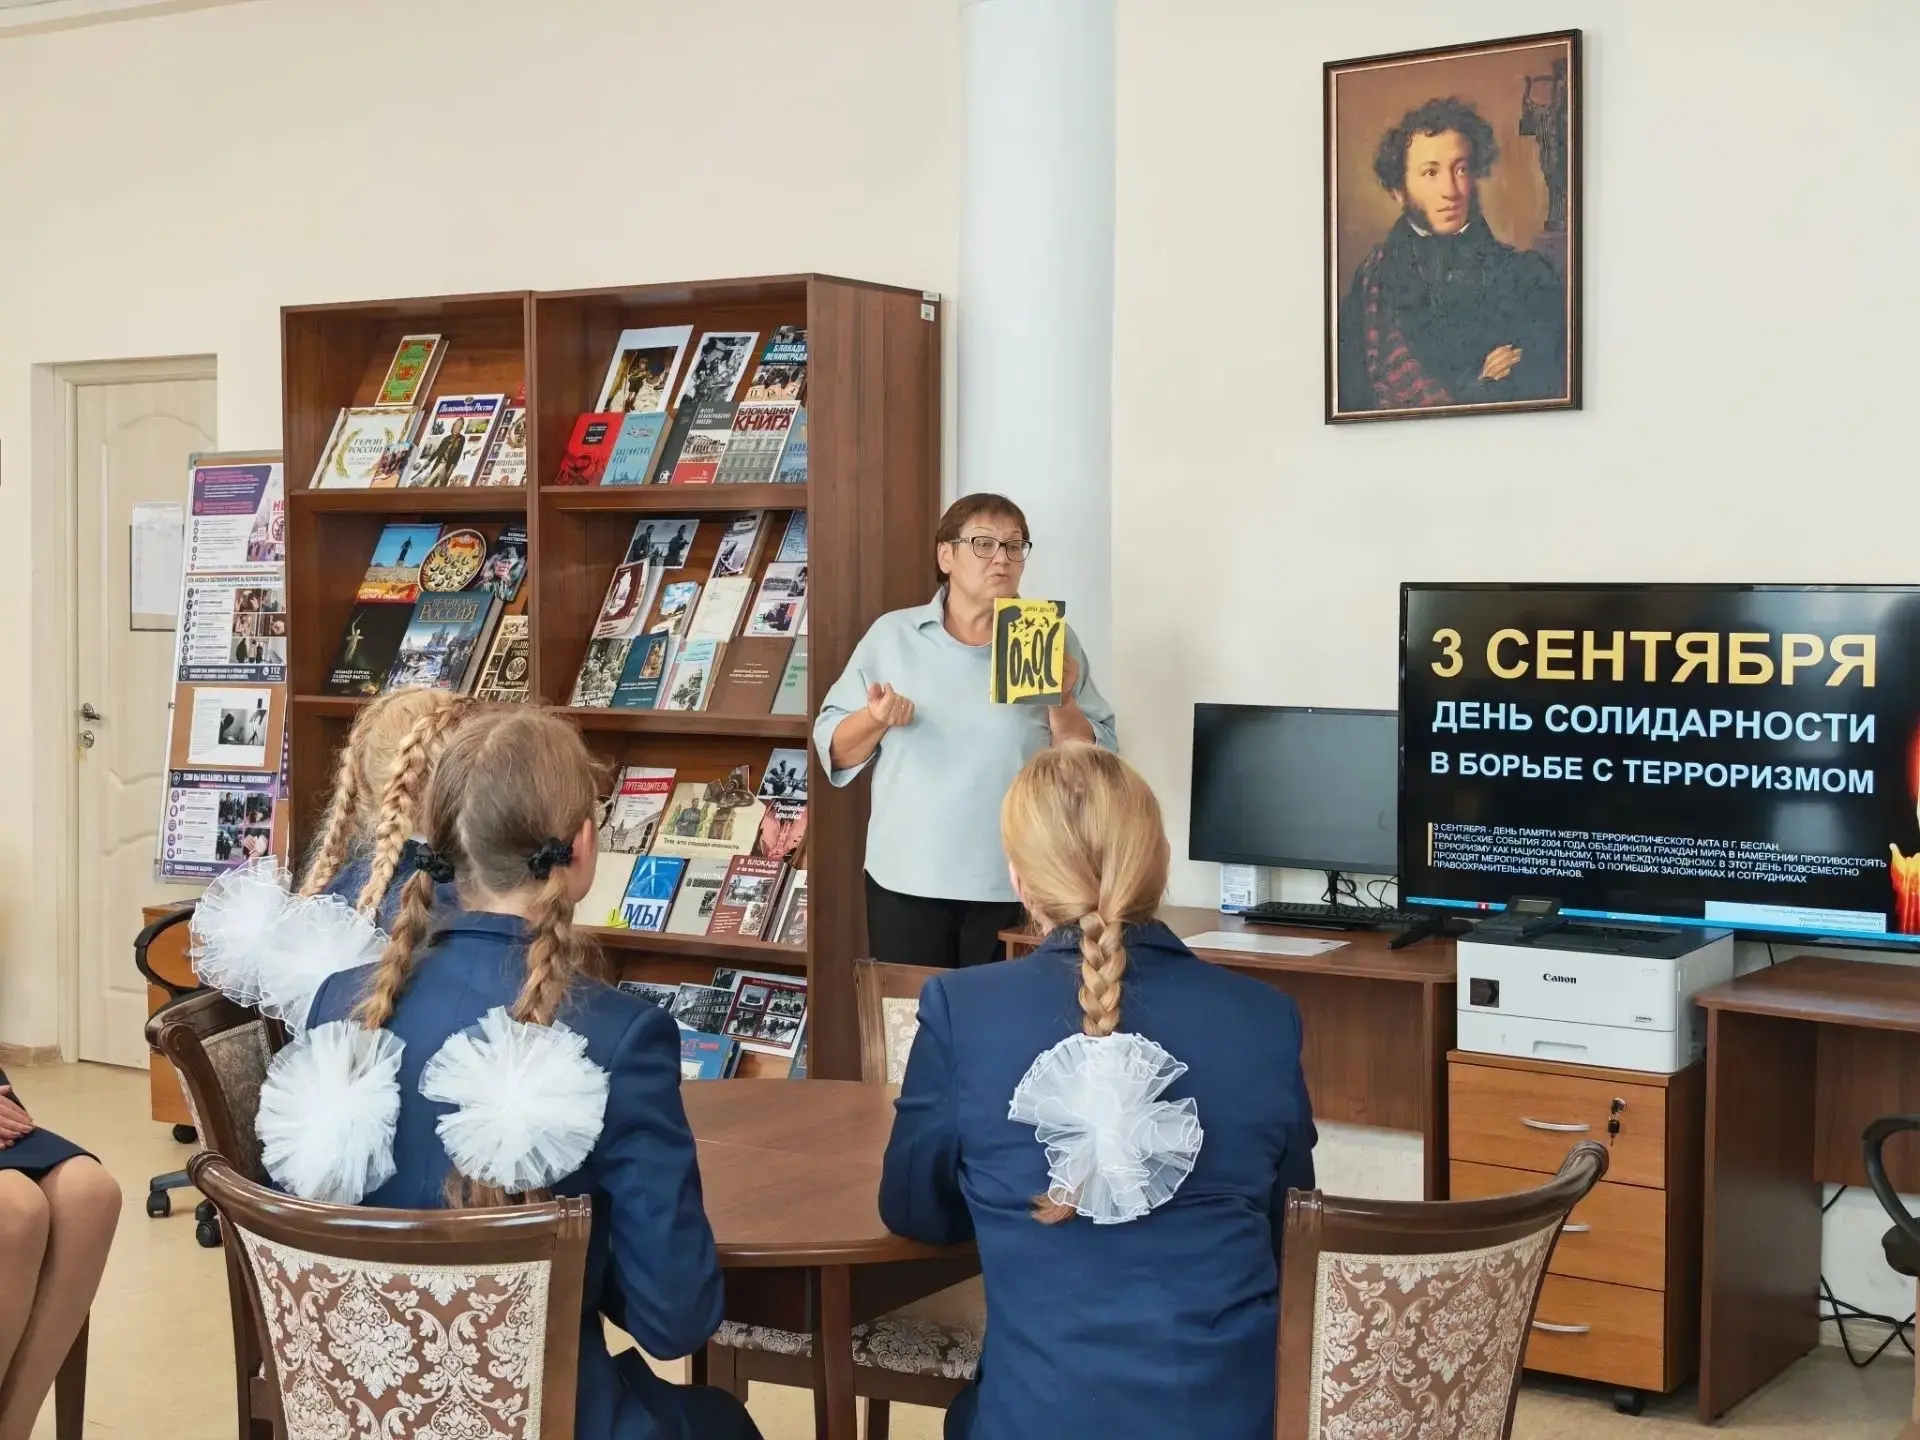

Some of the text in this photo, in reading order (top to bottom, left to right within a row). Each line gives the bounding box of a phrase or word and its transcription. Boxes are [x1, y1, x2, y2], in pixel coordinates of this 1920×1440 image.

[732, 415, 790, 431] КНИГА
[1431, 628, 1876, 687] 3 СЕНТЯБРЯ
[1432, 701, 1875, 743] ДЕНЬ СОЛИДАРНОСТИ
[624, 782, 669, 791] ПУТЕВОДИТЕЛЬ
[1431, 752, 1874, 794] В БОРЬБЕ С ТЕРРОРИЗМОМ
[1434, 833, 1887, 868] ТРАГИЧЕСКИЕ СОБЫТИЯ 2004 ГОДА ОБЪЕДИНИЛИ ГРАЖДАН МИРА В НАМЕРЕНИИ ПРОТИВОСТОЯТЬ
[1440, 824, 1486, 834] СЕНТЯБРЯ
[1493, 827, 1518, 836] ДЕНЬ
[1519, 829, 1556, 838] ПАМЯТИ
[1558, 830, 1589, 840] ЖЕРТВ
[1592, 832, 1694, 846] ТЕРРОРИСТИЧЕСКОГО
[1696, 839, 1720, 847] АКТА
[1740, 841, 1780, 851] БЕСЛАН.
[747, 859, 779, 868] БЛОКАДЕ
[1434, 842, 1859, 876] ТЕРРОРИЗМУ КАК НАЦИОНАЛЬНОМУ, ТАК И МЕЖДУНАРОДНОМУ. В ЭТОТ ДЕНЬ ПОВСЕМЕСТНО
[1434, 852, 1479, 862] ПРОХОДЯТ
[1482, 855, 1548, 866] МЕРОПРИЯТИЯ
[1558, 860, 1595, 869] ПАМЯТЬ
[1597, 862, 1605, 870] О
[1608, 863, 1658, 874] ПОГИБШИХ
[1661, 866, 1726, 878] ЗАЛОЖНИКАХ
[1737, 872, 1807, 883] СОТРУДНИКАХ
[1434, 861, 1584, 878] ПРАВООХРАНИТЕЛЬНЫХ ОРГАНОВ.
[623, 903, 664, 928] МЫ
[1543, 973, 1576, 984] Canon
